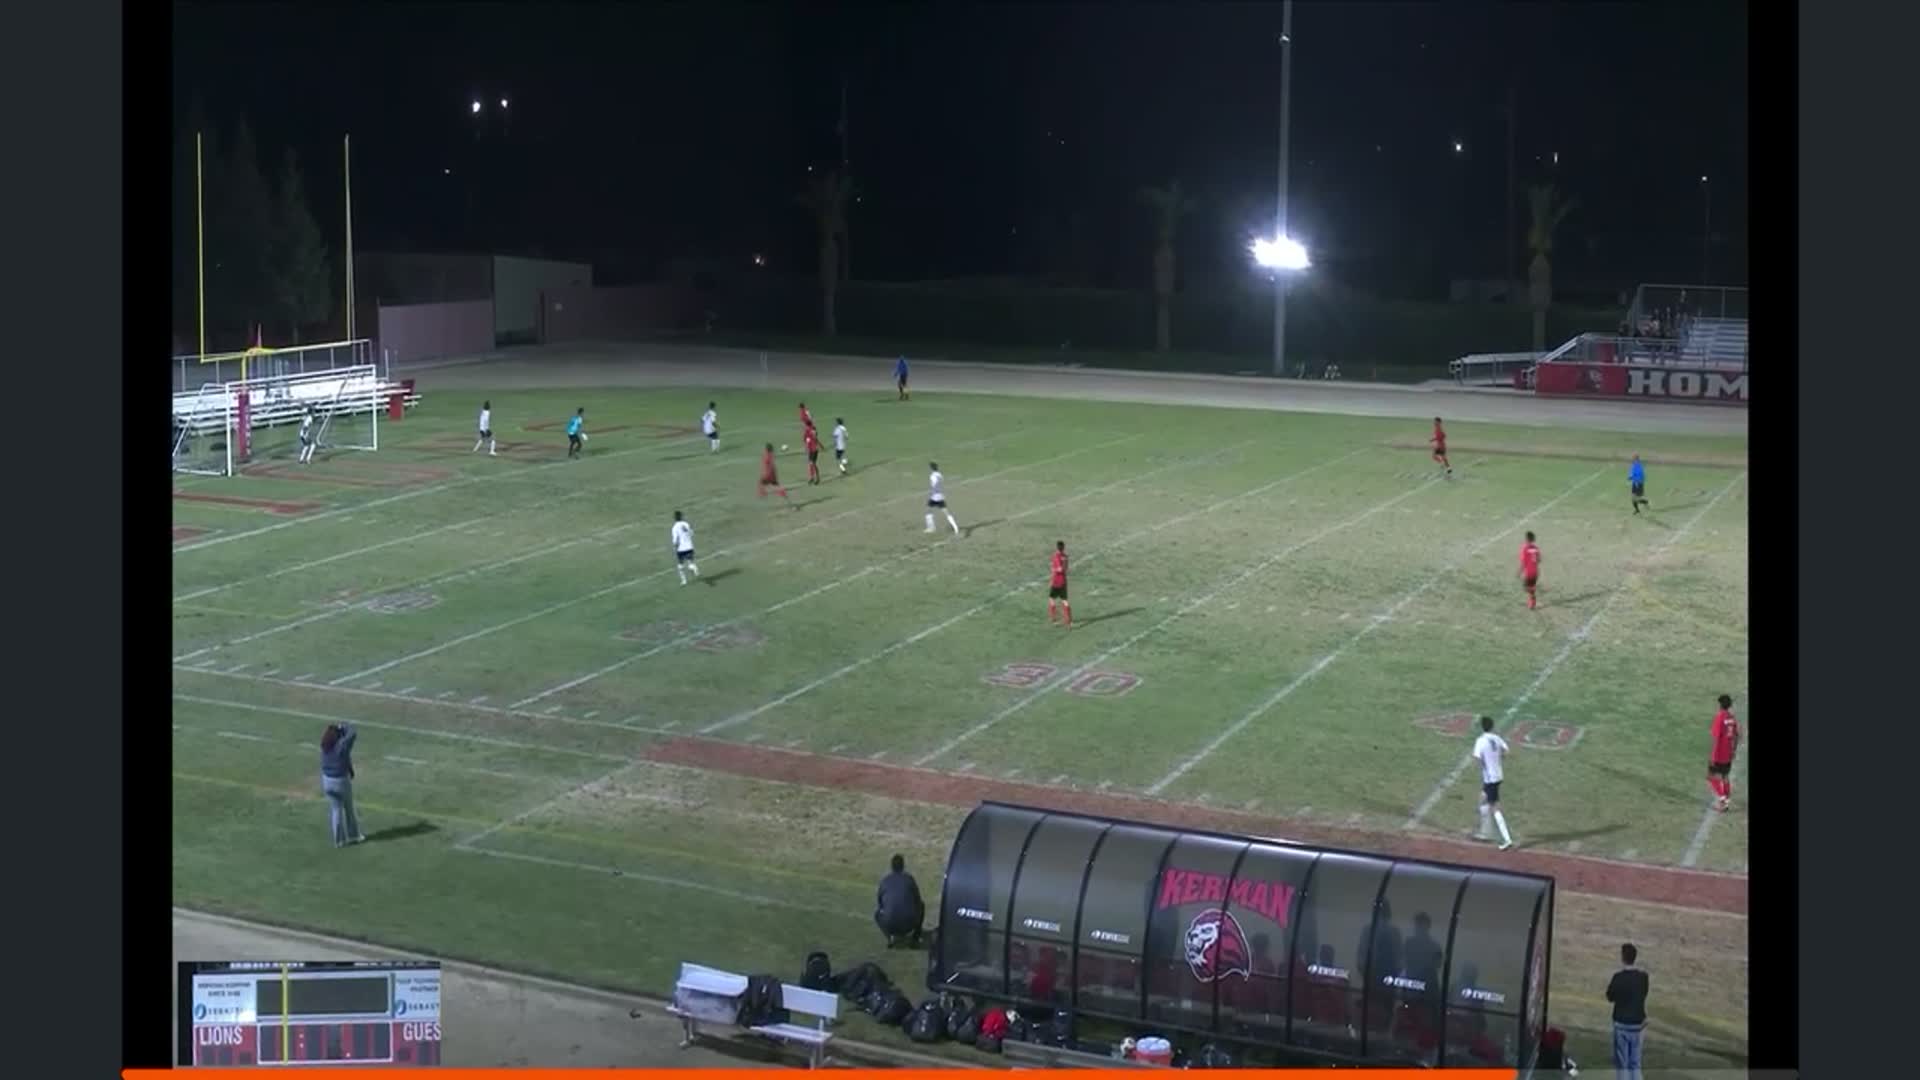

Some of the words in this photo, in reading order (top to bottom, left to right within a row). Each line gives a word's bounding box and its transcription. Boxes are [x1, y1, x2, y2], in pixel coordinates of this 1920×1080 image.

[1628, 369, 1748, 400] HOM
[981, 662, 1144, 696] 30
[1157, 867, 1296, 929] KERMAN
[199, 1026, 243, 1046] LIONS
[402, 1022, 442, 1041] GUES
